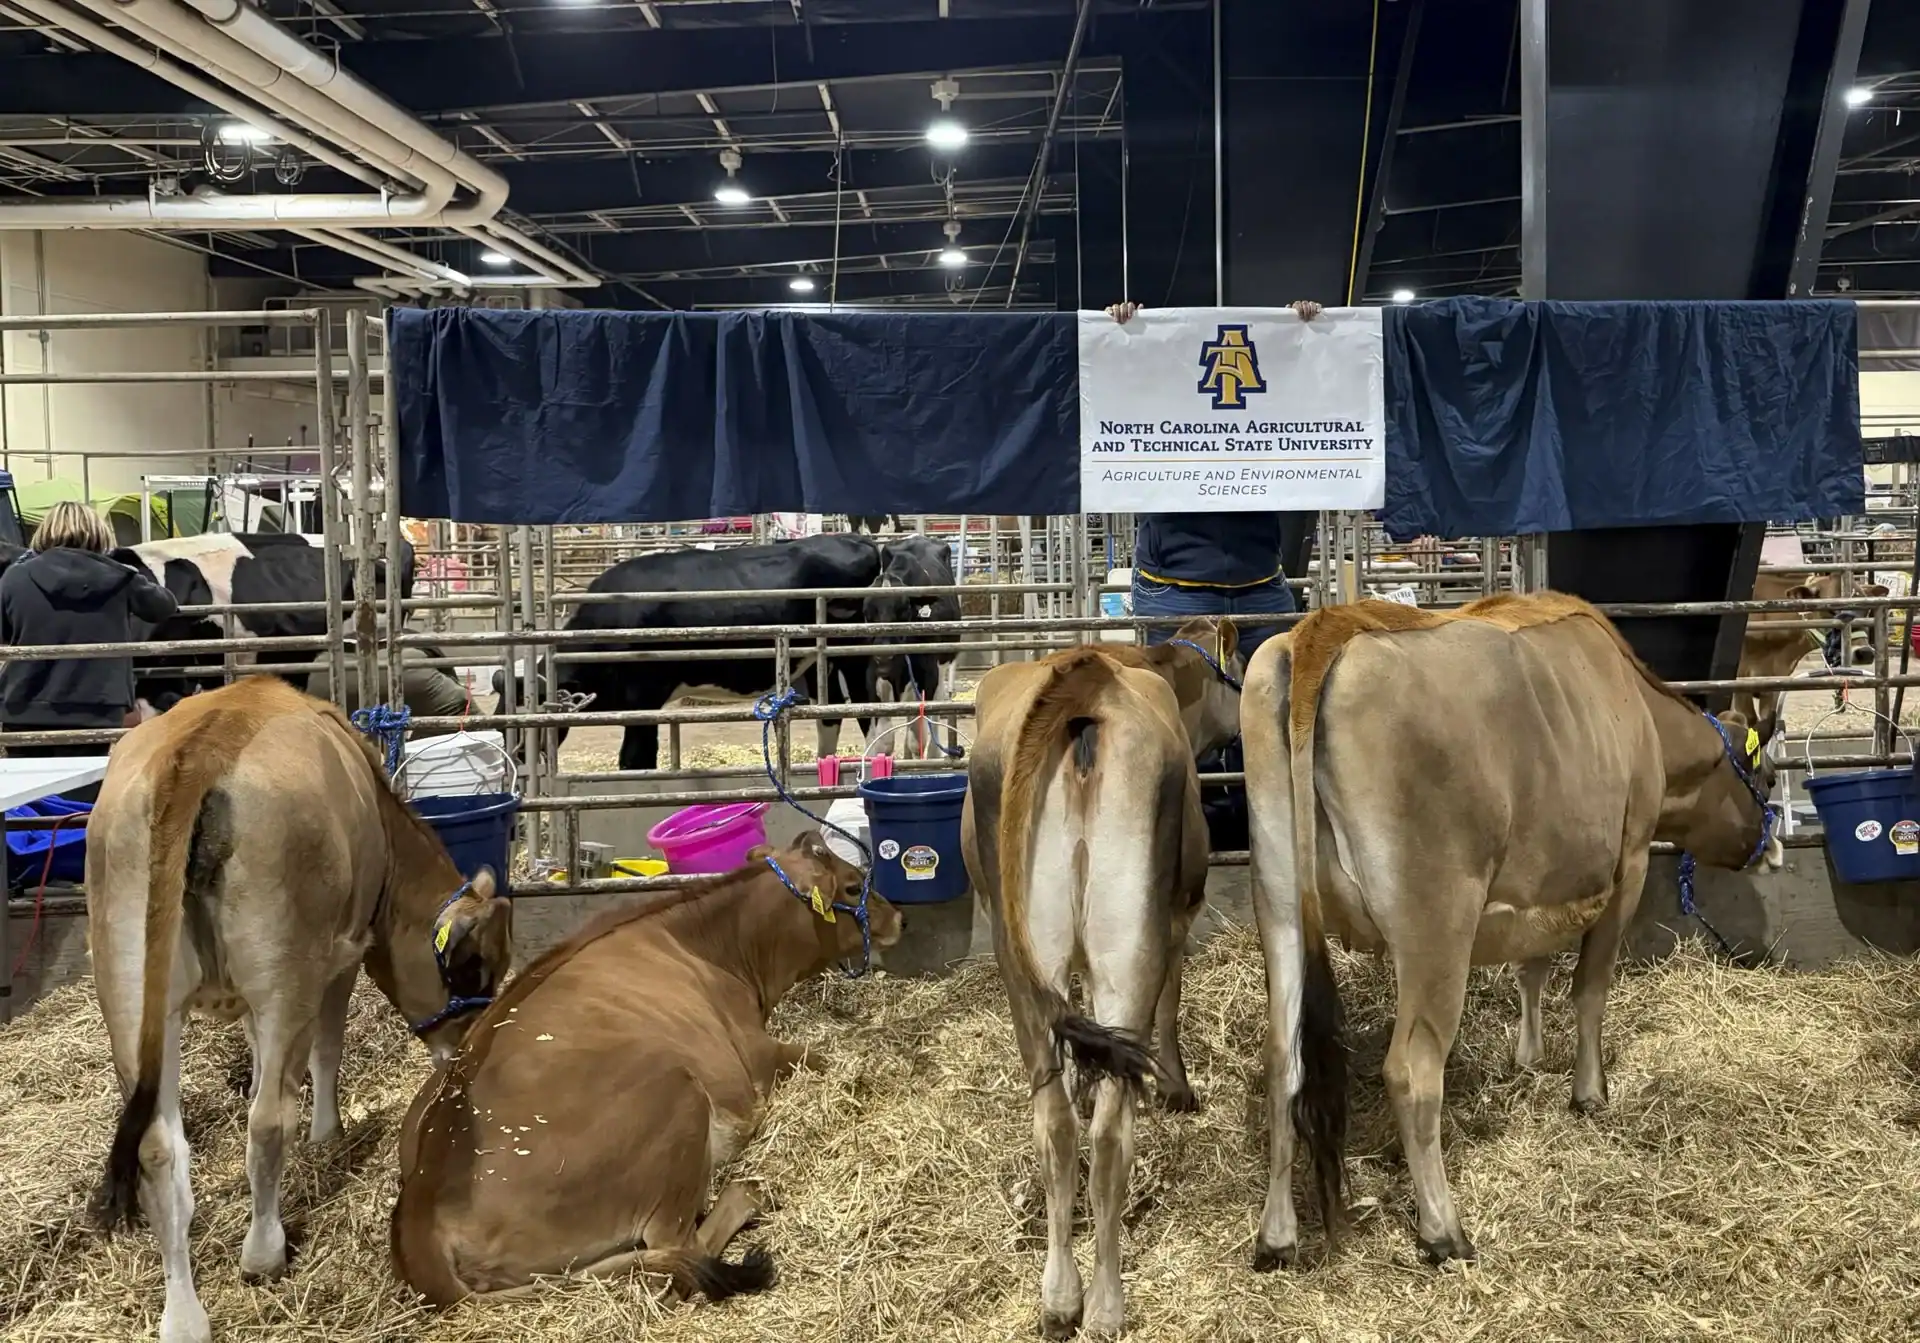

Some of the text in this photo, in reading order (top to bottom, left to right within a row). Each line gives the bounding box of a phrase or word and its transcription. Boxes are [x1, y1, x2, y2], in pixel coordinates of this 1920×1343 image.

[1100, 420, 1364, 435] NORTH CAROLINA AGRICULTURAL
[1092, 438, 1373, 452] AND TECHNICAL STATE UNIVERSITY
[1102, 468, 1362, 482] AGRICULTURE AND ENVIRONMENTAL
[1198, 483, 1267, 496] SCIENCES
